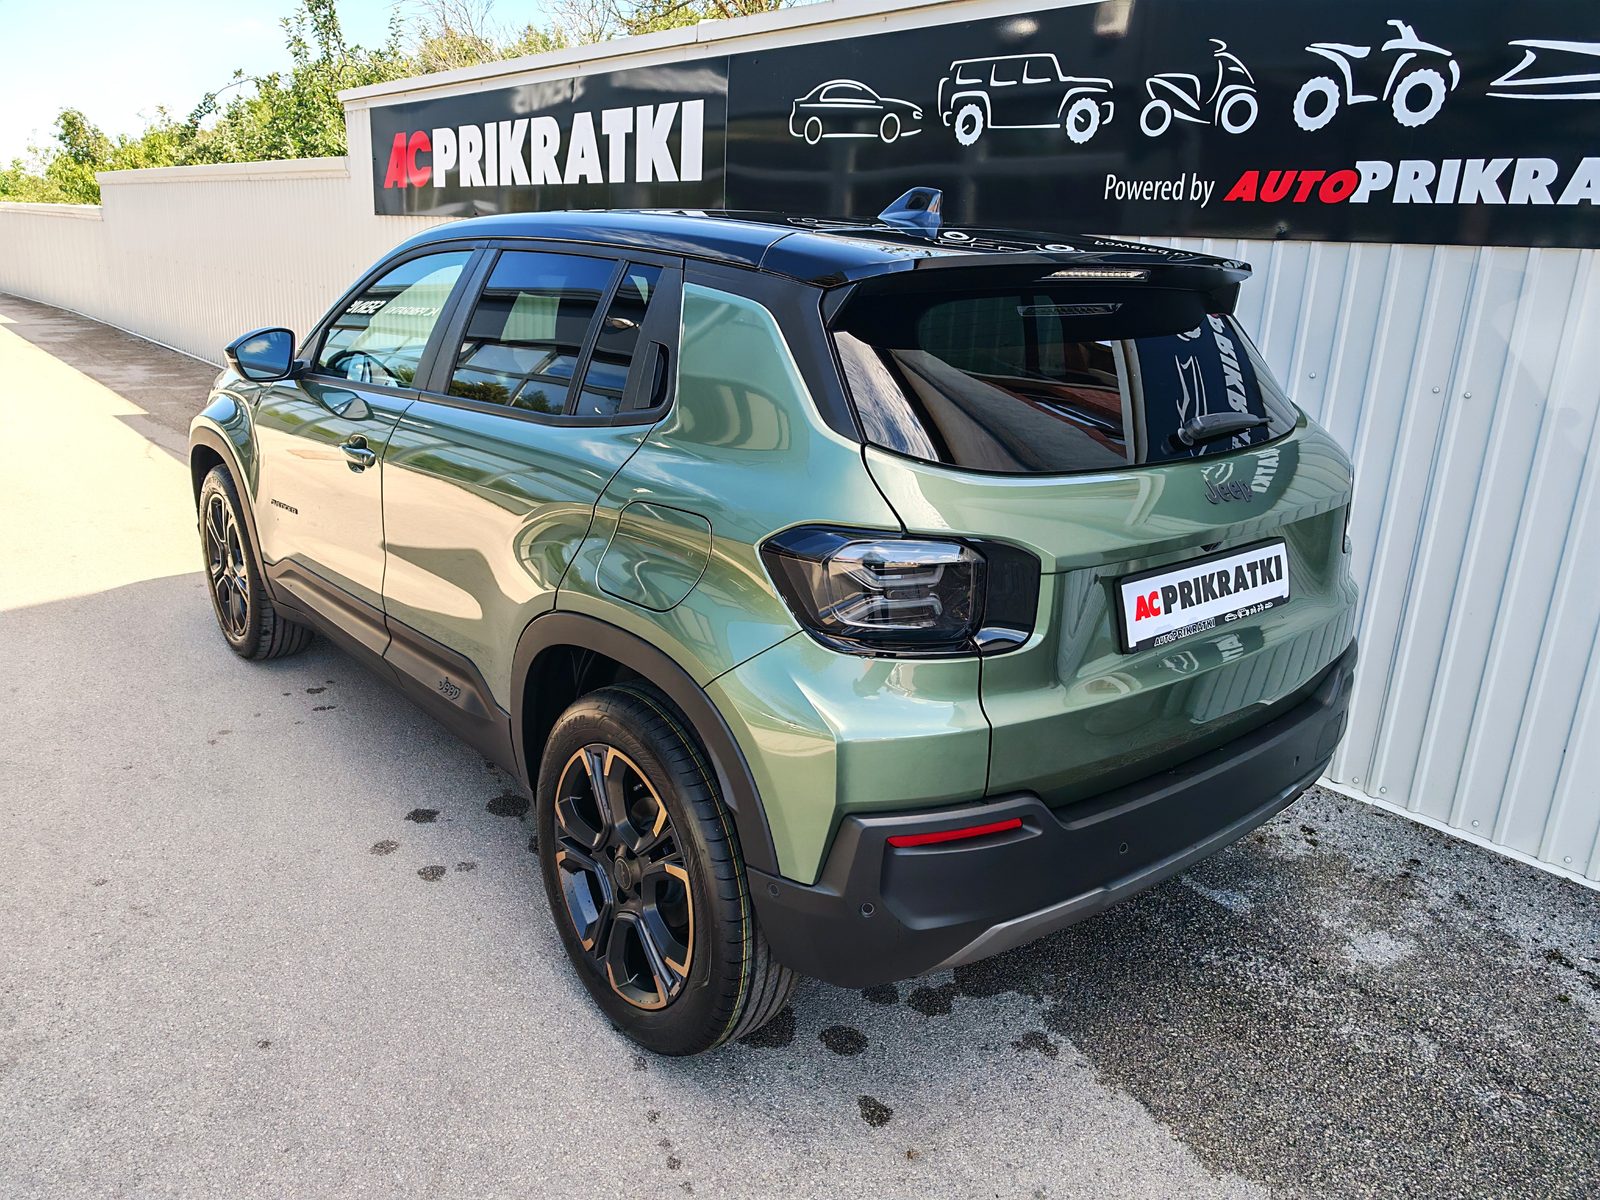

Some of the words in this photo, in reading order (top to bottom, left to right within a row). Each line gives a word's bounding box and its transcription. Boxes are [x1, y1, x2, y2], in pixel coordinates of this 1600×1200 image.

[384, 99, 705, 188] ACPRIKRATKI
[1104, 173, 1185, 204] Powered
[1190, 171, 1215, 208] by
[1204, 481, 1252, 504] Jeep
[1135, 555, 1283, 622] ACPRIKRATKI
[1153, 617, 1216, 647] AUTOPRIKRATKI
[438, 676, 461, 700] Jeep
